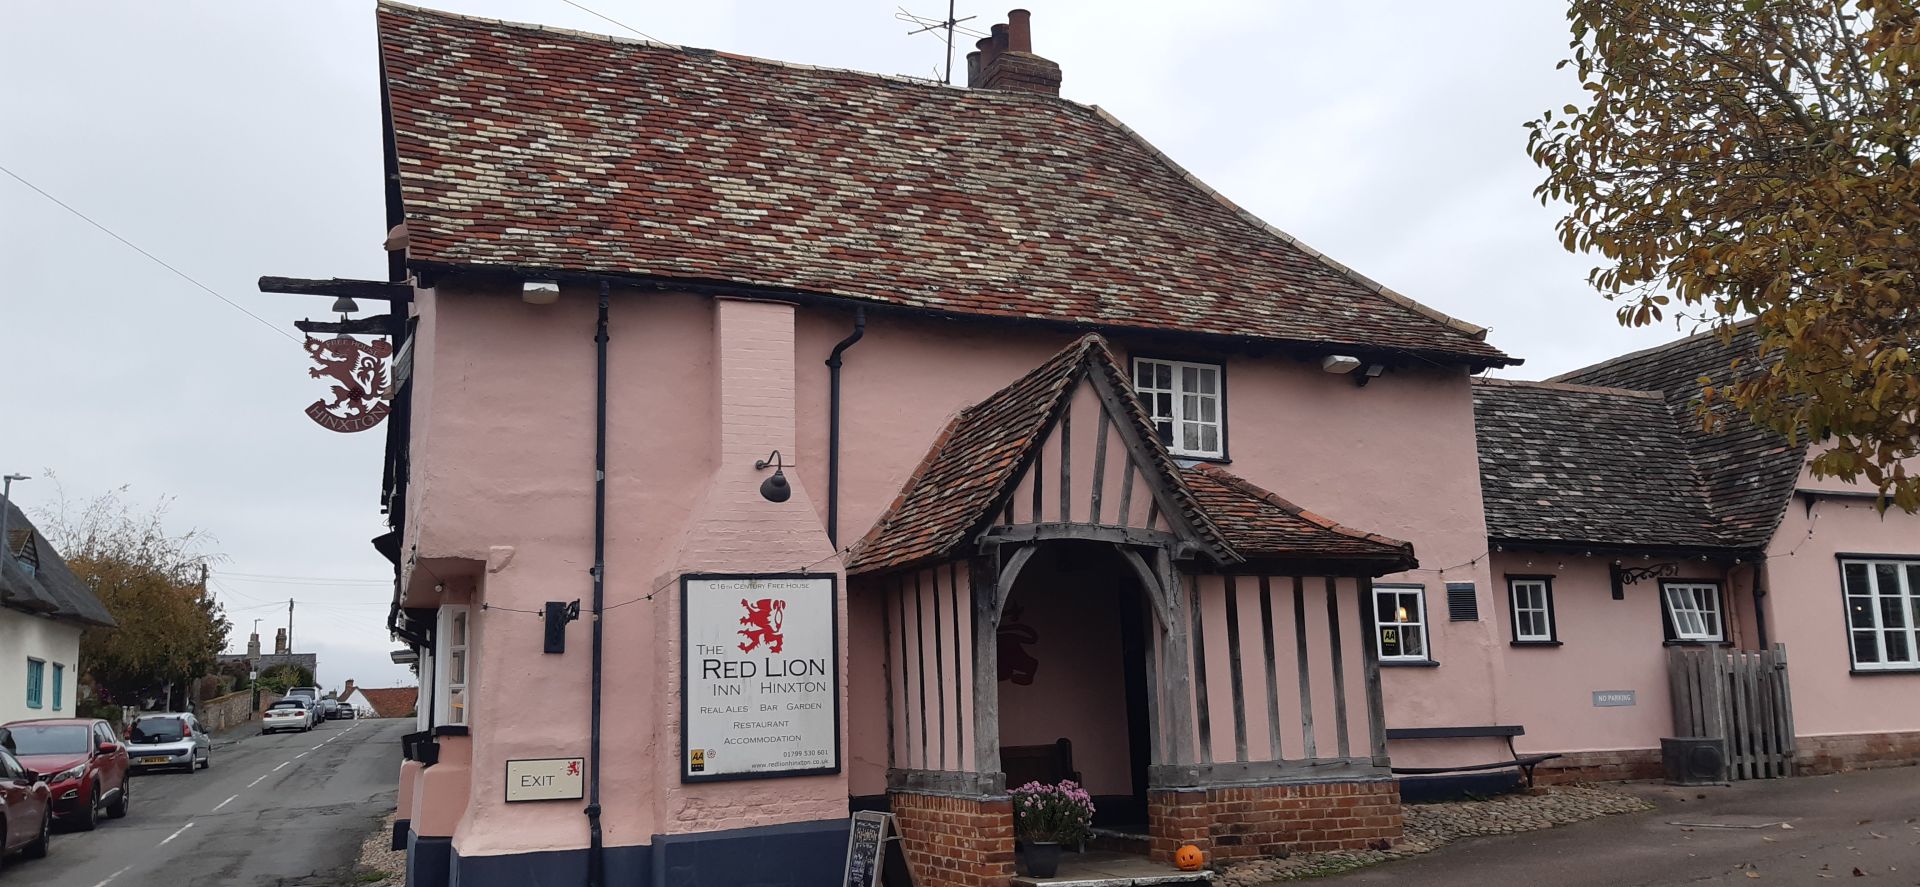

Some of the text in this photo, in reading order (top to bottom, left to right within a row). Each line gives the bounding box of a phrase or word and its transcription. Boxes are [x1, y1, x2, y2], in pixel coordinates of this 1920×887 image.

[325, 339, 378, 357] FREE HOUSE
[310, 405, 385, 431] HINXTON
[1384, 630, 1395, 640] AA
[696, 644, 723, 655] THE
[702, 657, 825, 679] RED LION
[713, 681, 826, 697] INN HINXTON
[1607, 694, 1631, 702] PARKING
[700, 702, 822, 714] REAL ALES BAR GARDEN
[733, 720, 790, 730] RESTAURANT
[724, 735, 802, 745] ACCOMMODATION
[692, 752, 703, 760] AA
[521, 775, 555, 787] EXIT
